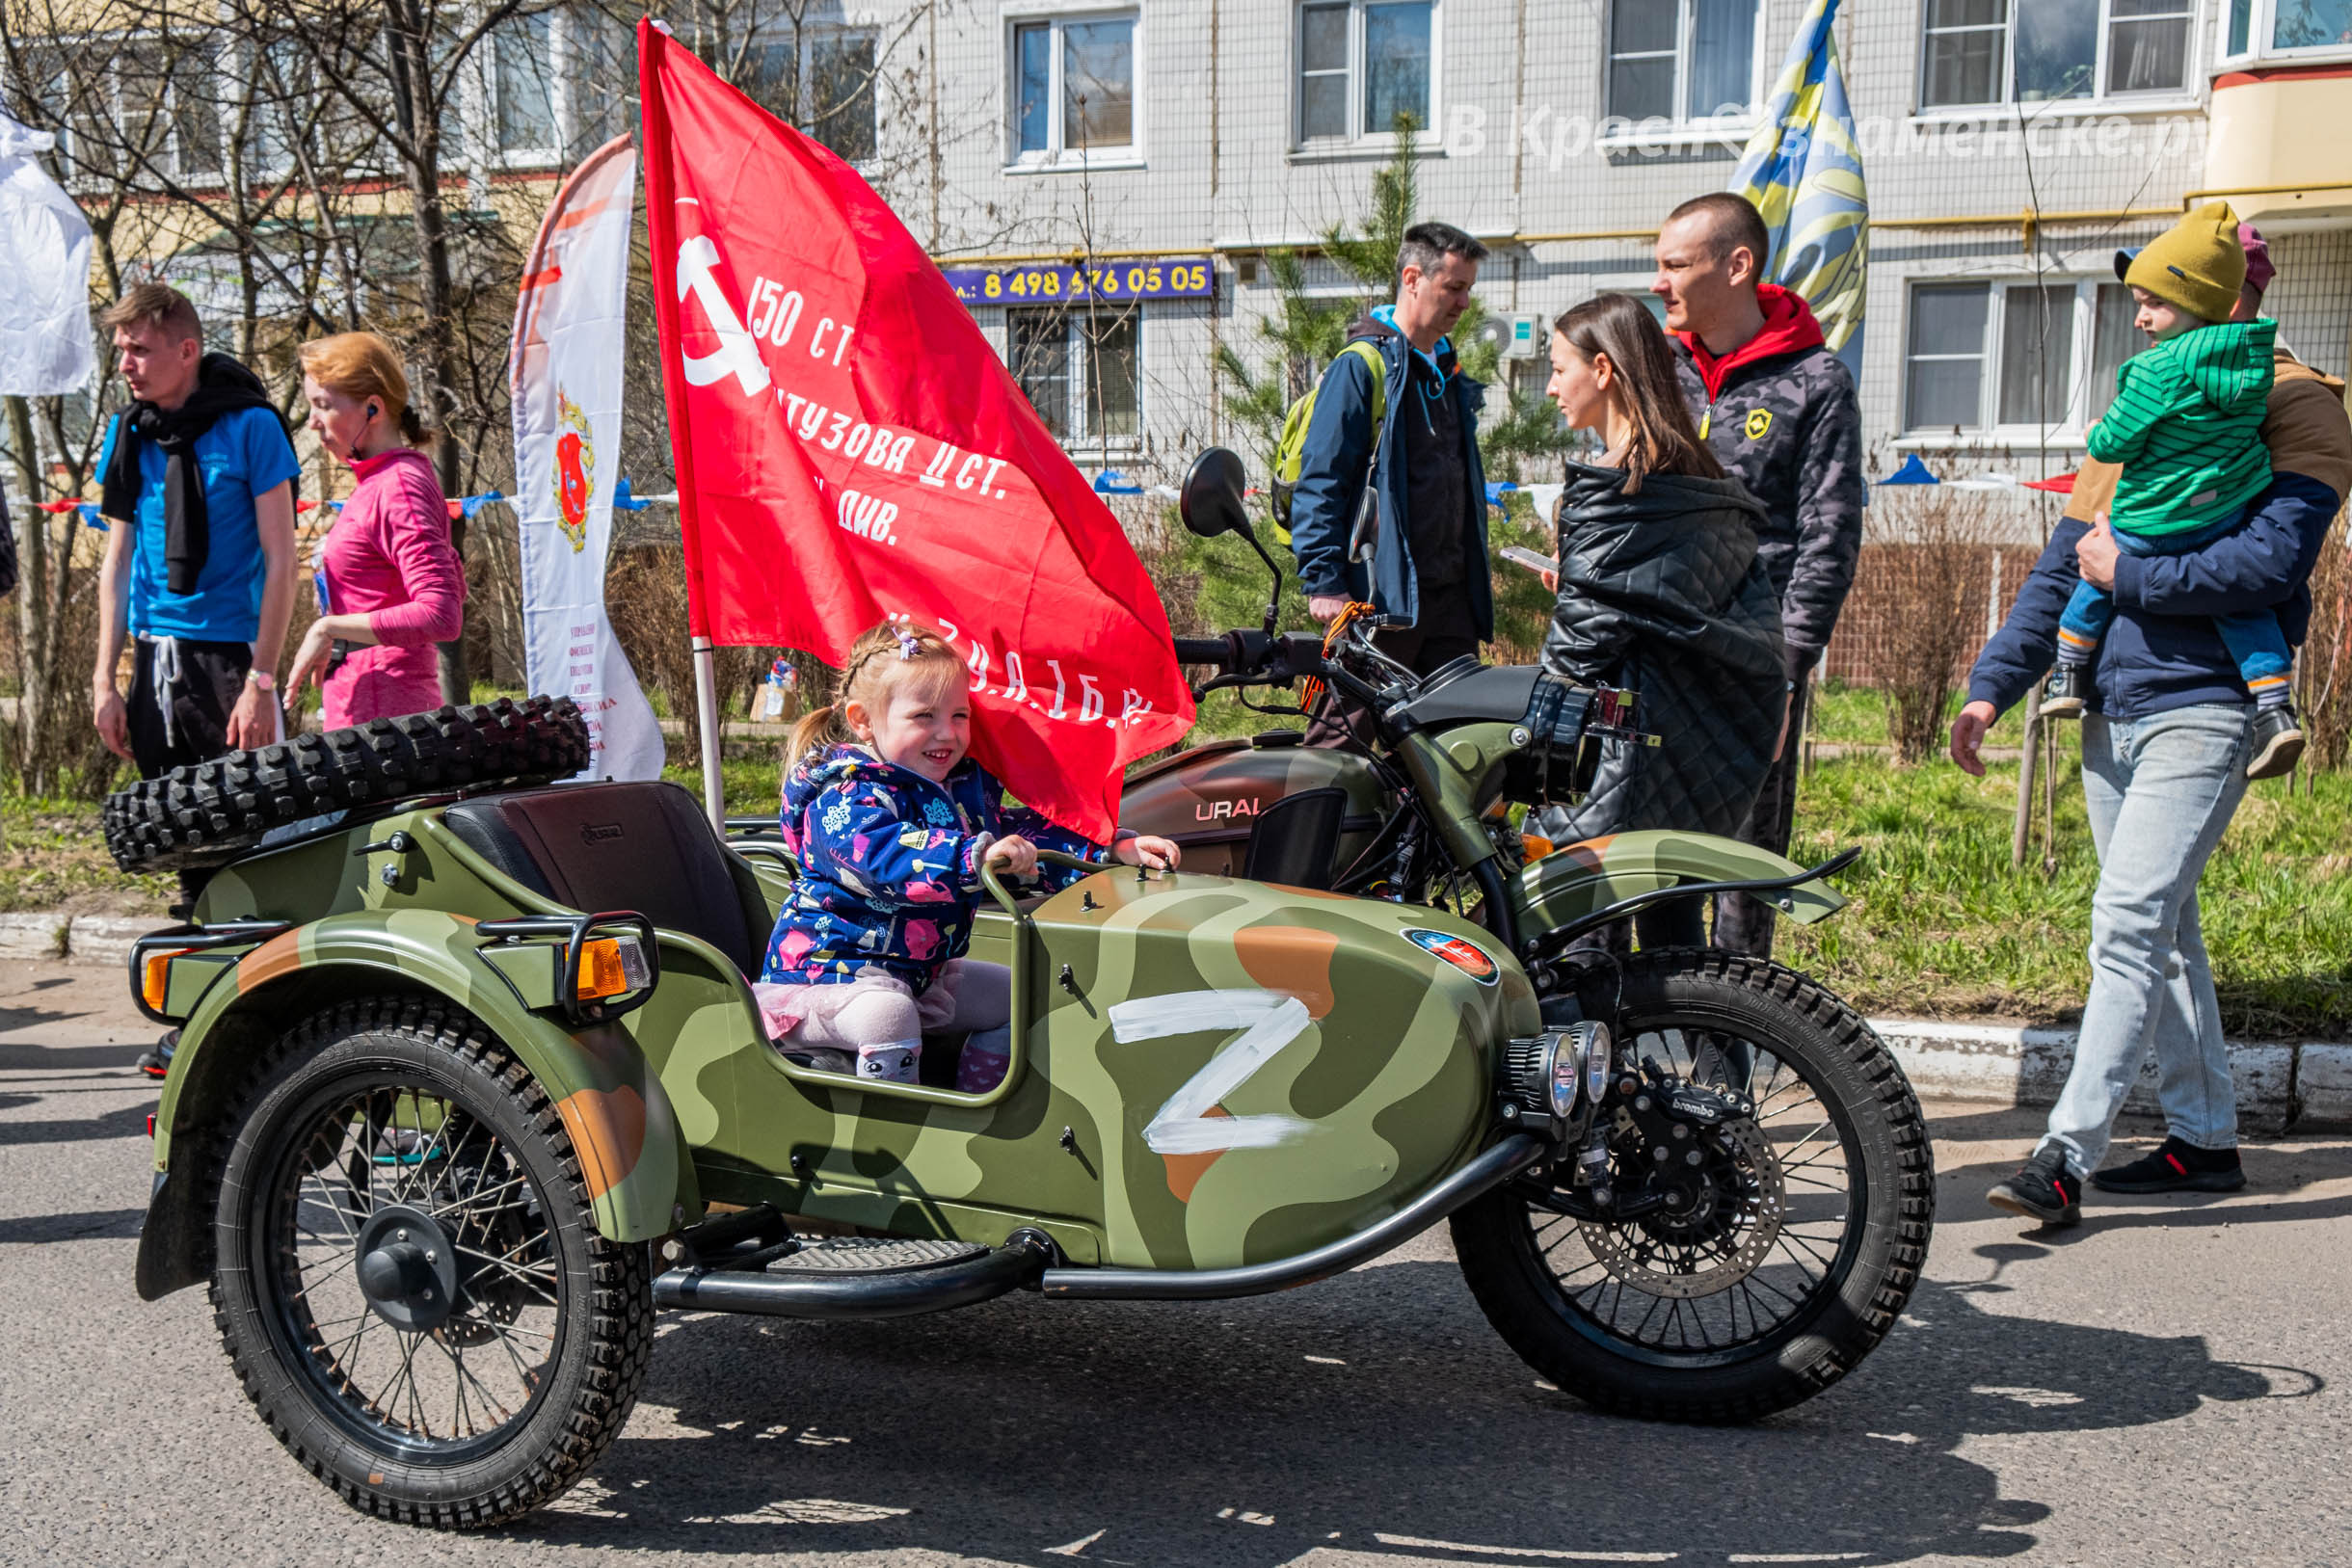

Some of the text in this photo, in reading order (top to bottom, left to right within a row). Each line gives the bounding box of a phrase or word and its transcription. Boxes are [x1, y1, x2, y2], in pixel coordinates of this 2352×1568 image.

[984, 274, 1002, 298] 8
[1010, 271, 1060, 297] 498
[1127, 267, 1162, 292] 05
[1170, 266, 1206, 291] 05
[747, 276, 856, 373] 150 СТ
[773, 386, 916, 474] ТУЗОВА
[955, 452, 1008, 499] СТ.
[838, 489, 899, 546] ДИВ.
[1195, 797, 1261, 821] URAL
[1108, 988, 1319, 1155] Z
[1672, 1098, 1715, 1118] brembo
